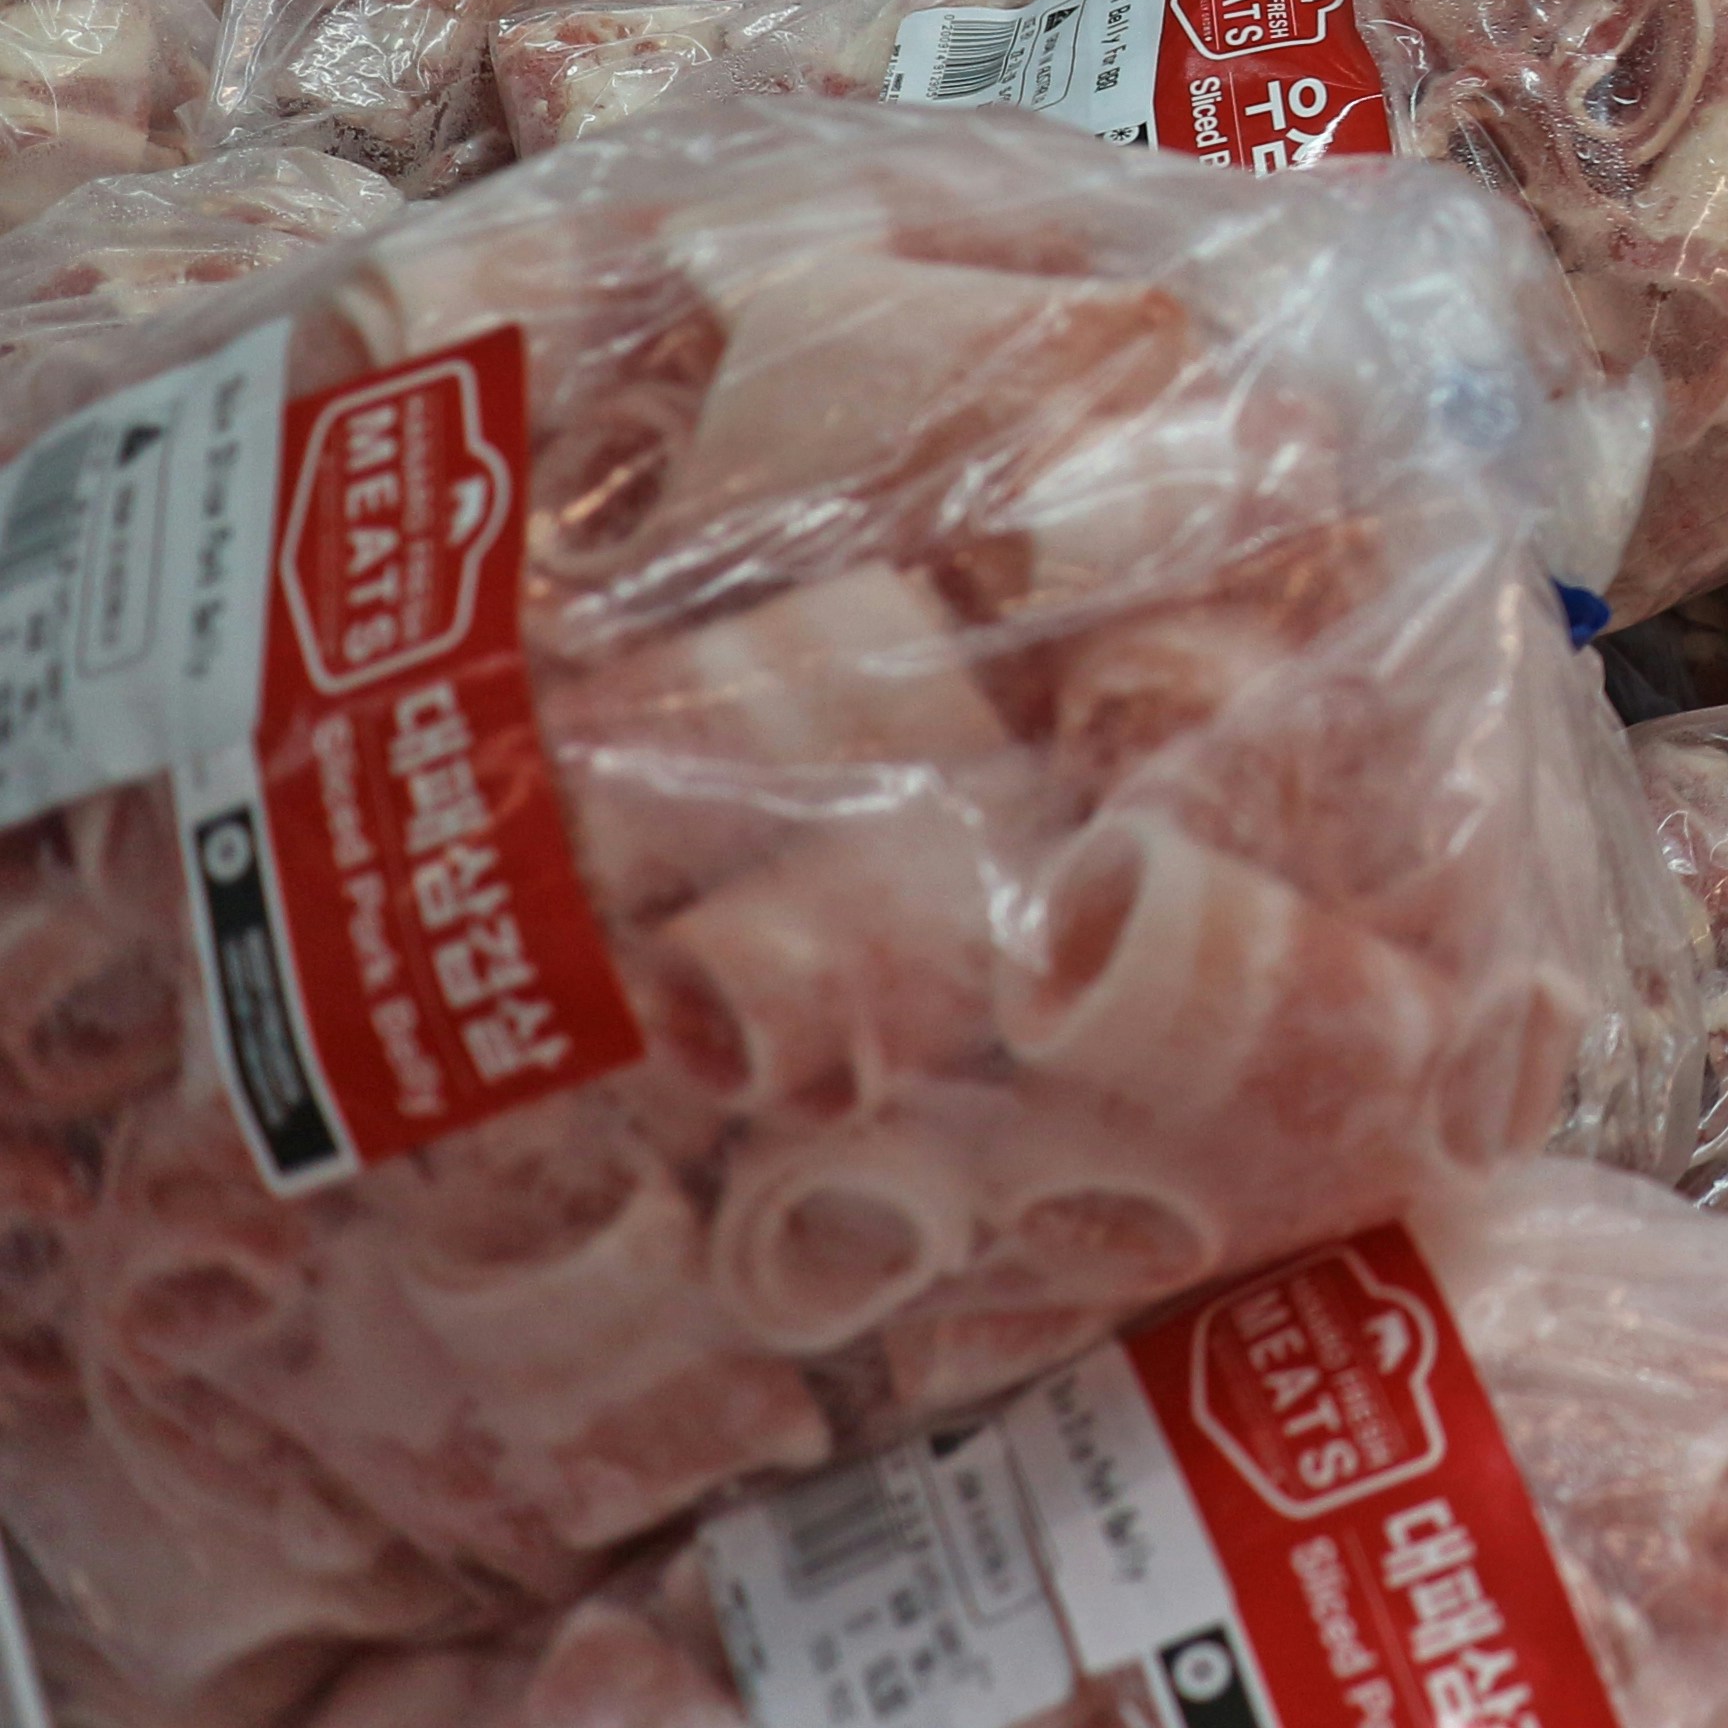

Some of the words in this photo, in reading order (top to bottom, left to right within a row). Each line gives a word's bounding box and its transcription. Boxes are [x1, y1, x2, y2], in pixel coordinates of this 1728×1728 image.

[1101, 3, 1132, 45] Belly
[1189, 75, 1229, 149] Sliced
[346, 404, 397, 663] MEATS
[389, 681, 574, 1084] 대패삼겹살
[1229, 1288, 1361, 1491] MEATS
[1291, 1534, 1376, 1679] Sliced
